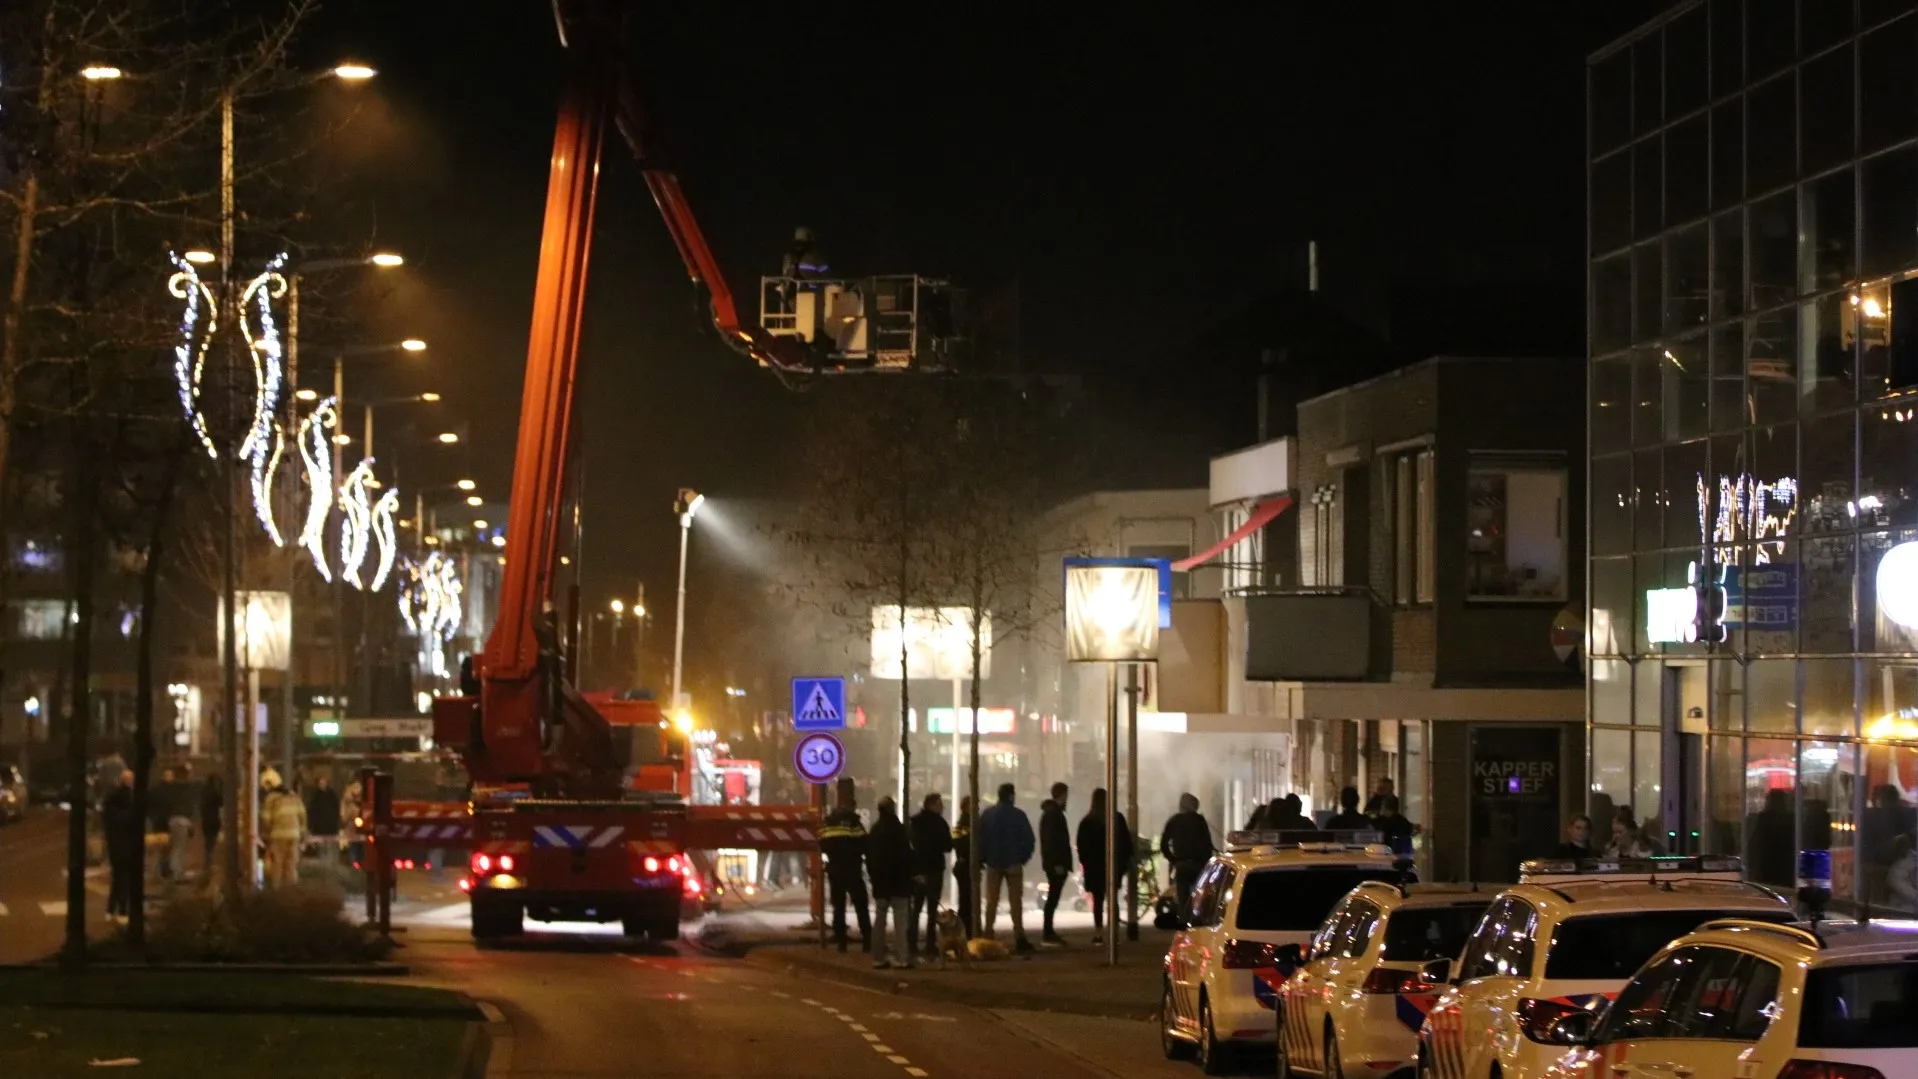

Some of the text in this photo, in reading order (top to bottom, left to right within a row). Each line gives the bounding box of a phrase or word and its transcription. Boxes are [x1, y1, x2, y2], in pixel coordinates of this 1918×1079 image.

[807, 748, 834, 765] 30
[1474, 761, 1554, 777] KAPPER
[1483, 778, 1544, 793] STEF
